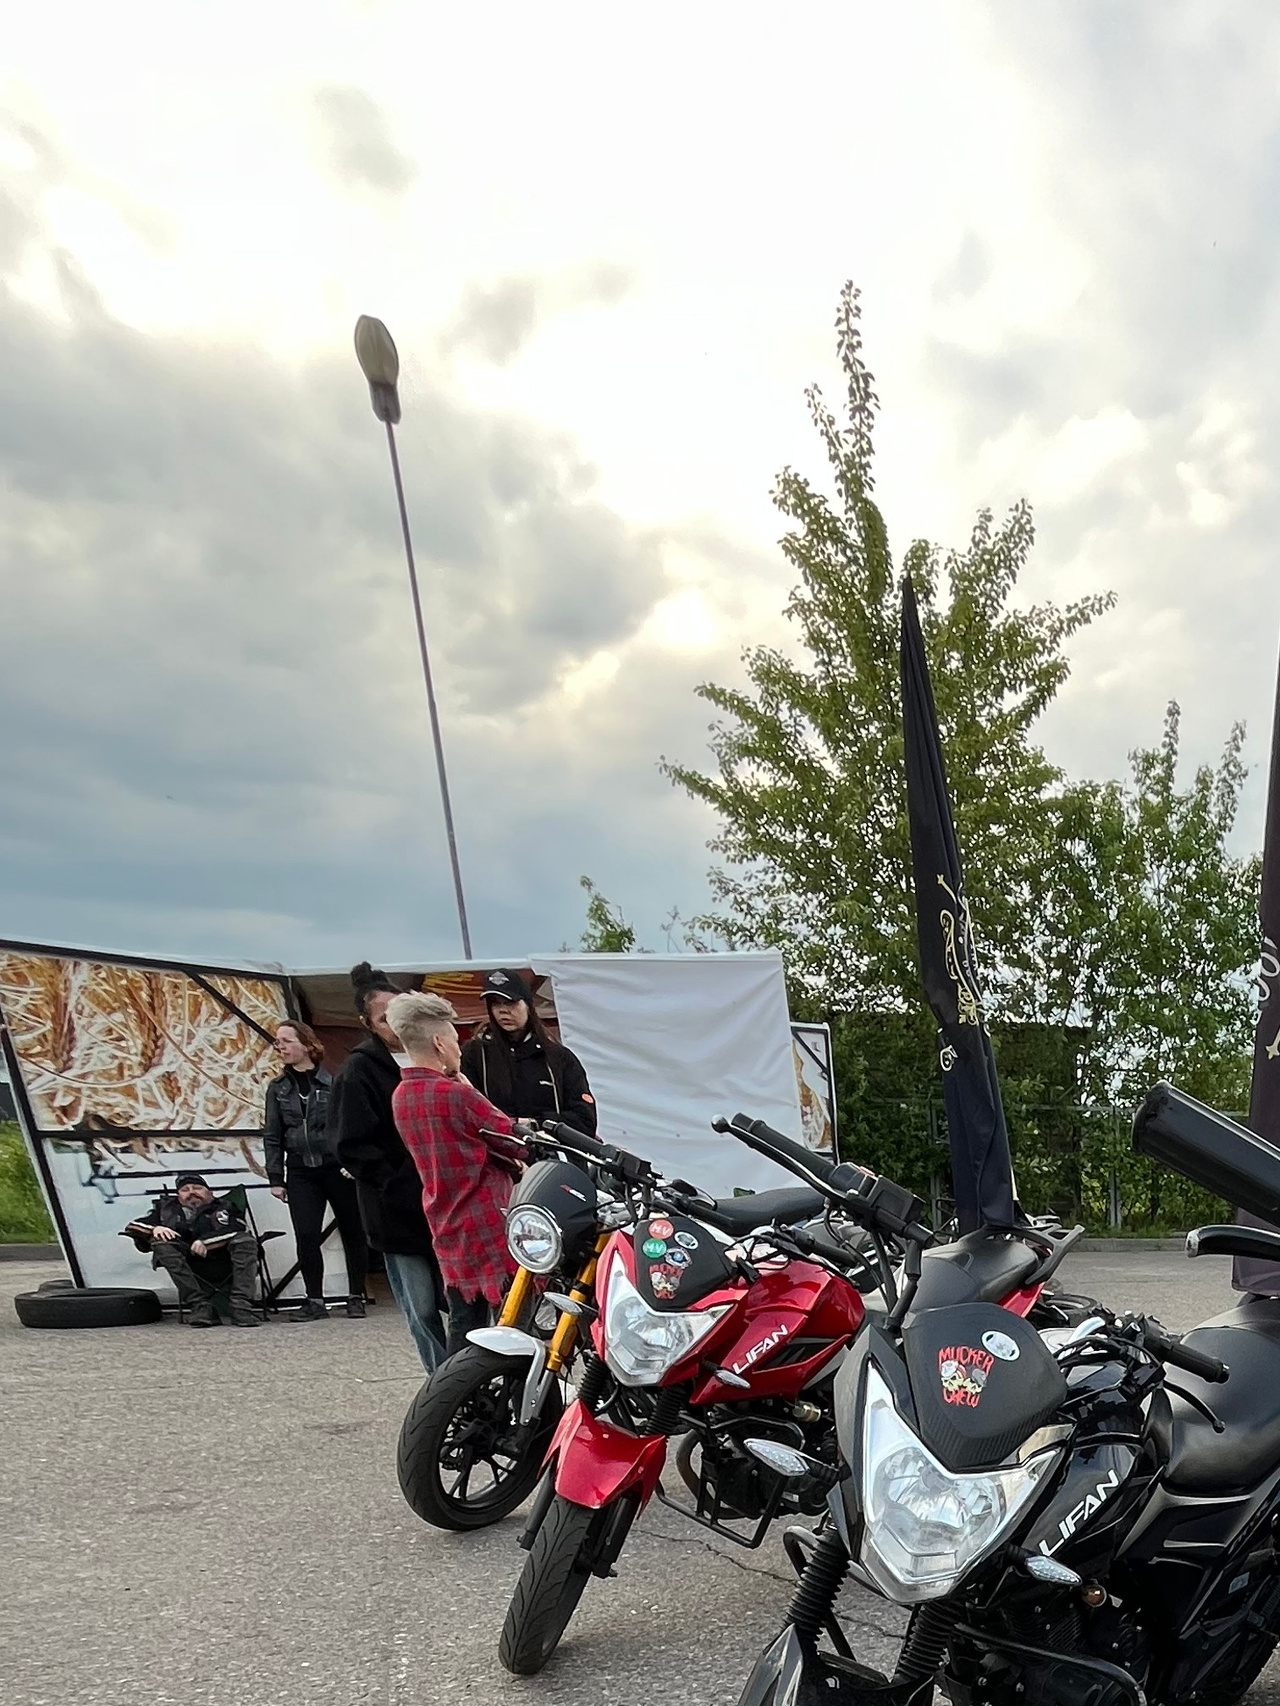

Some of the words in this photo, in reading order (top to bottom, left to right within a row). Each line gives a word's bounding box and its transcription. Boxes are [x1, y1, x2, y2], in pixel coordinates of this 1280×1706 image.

[732, 1324, 788, 1374] LIFAN
[938, 1346, 994, 1377] MUCKER
[943, 1387, 980, 1408] CREW
[1038, 1469, 1119, 1557] LIFAN
